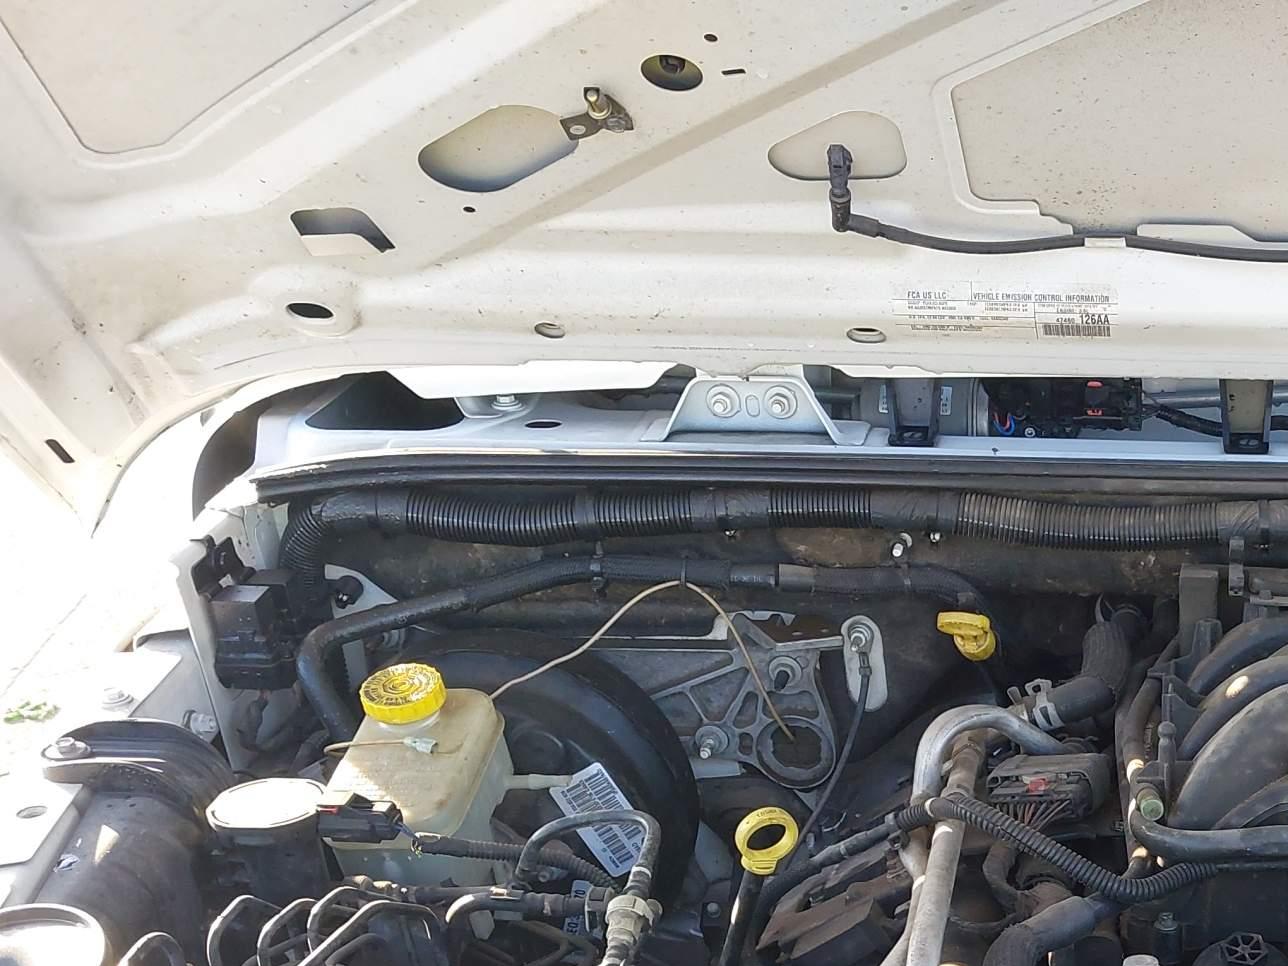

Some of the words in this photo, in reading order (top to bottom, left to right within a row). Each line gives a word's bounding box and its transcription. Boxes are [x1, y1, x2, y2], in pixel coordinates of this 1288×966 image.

[908, 291, 920, 299] FCA
[922, 291, 932, 299] US
[934, 291, 947, 299] LLC
[973, 292, 1000, 300] VEHICLE
[1001, 292, 1032, 301] EMISSION
[1034, 293, 1064, 301] CONTROL
[1065, 294, 1110, 302] INFORMATION
[1079, 313, 1110, 325] 126AA
